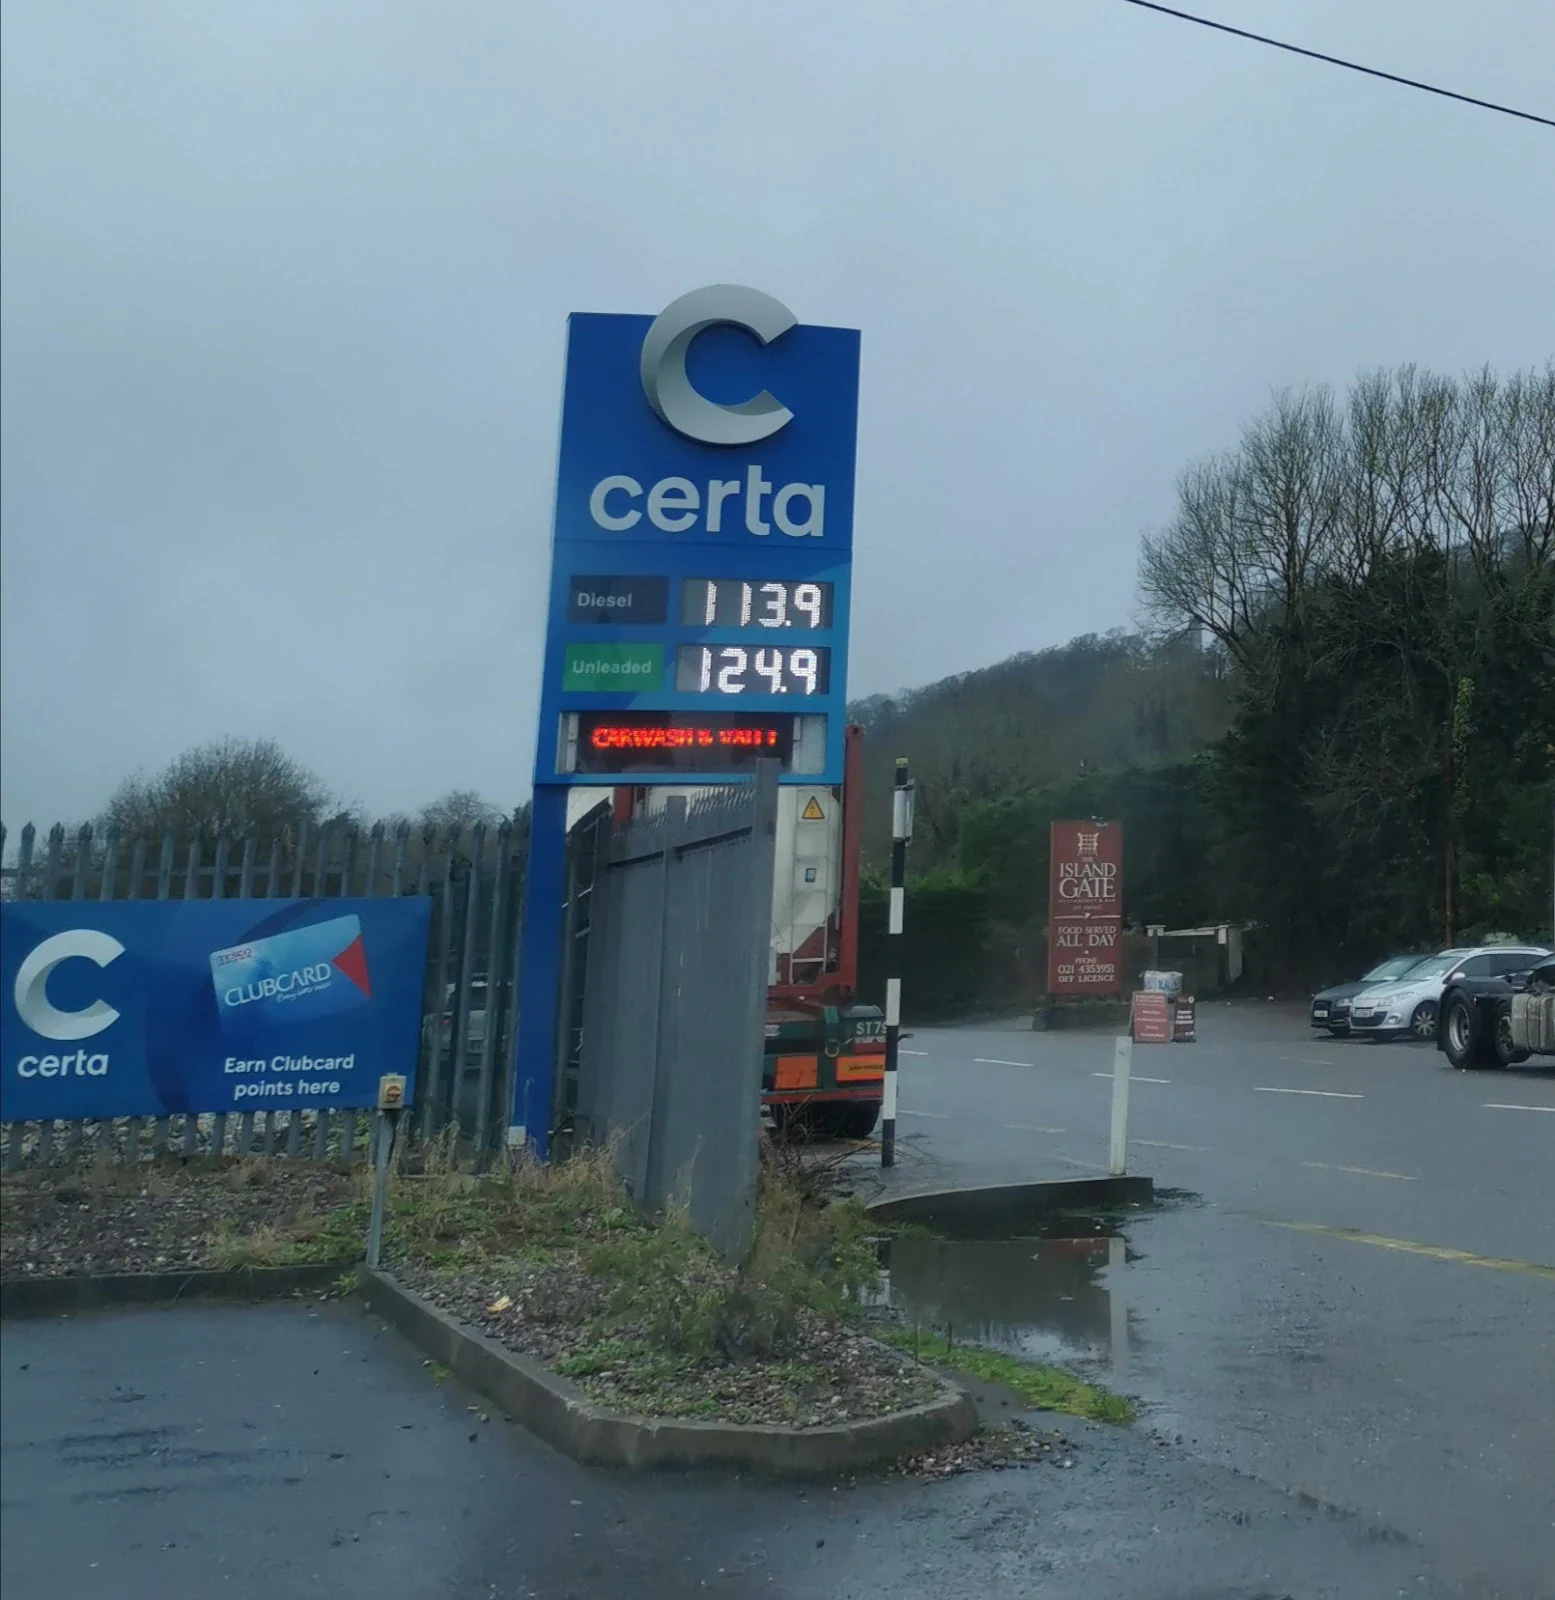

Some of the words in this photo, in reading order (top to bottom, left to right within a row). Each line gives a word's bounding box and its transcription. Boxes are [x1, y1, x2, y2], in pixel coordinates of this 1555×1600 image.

[589, 464, 826, 537] certa
[577, 592, 632, 608] Diesel
[705, 580, 821, 629] 113.9
[572, 659, 652, 674] Unleaded
[700, 647, 818, 695] 124.9
[1060, 862, 1117, 878] ISLAND
[1059, 877, 1117, 899] GATE
[1058, 926, 1083, 935] FOOD
[1085, 925, 1117, 935] SERVED
[1056, 934, 1083, 947] ALL
[1089, 933, 1117, 947] DAY
[218, 948, 253, 962] TESCO
[1058, 964, 1075, 974] 021
[224, 962, 331, 1007] CLUBCARD
[1058, 975, 1075, 983] OFF
[1078, 974, 1116, 983] LICENCE
[17, 1049, 110, 1078] certa
[224, 1057, 267, 1073] Earn
[271, 1053, 355, 1072] Clubcard
[233, 1080, 294, 1102] points
[298, 1079, 340, 1095] here
